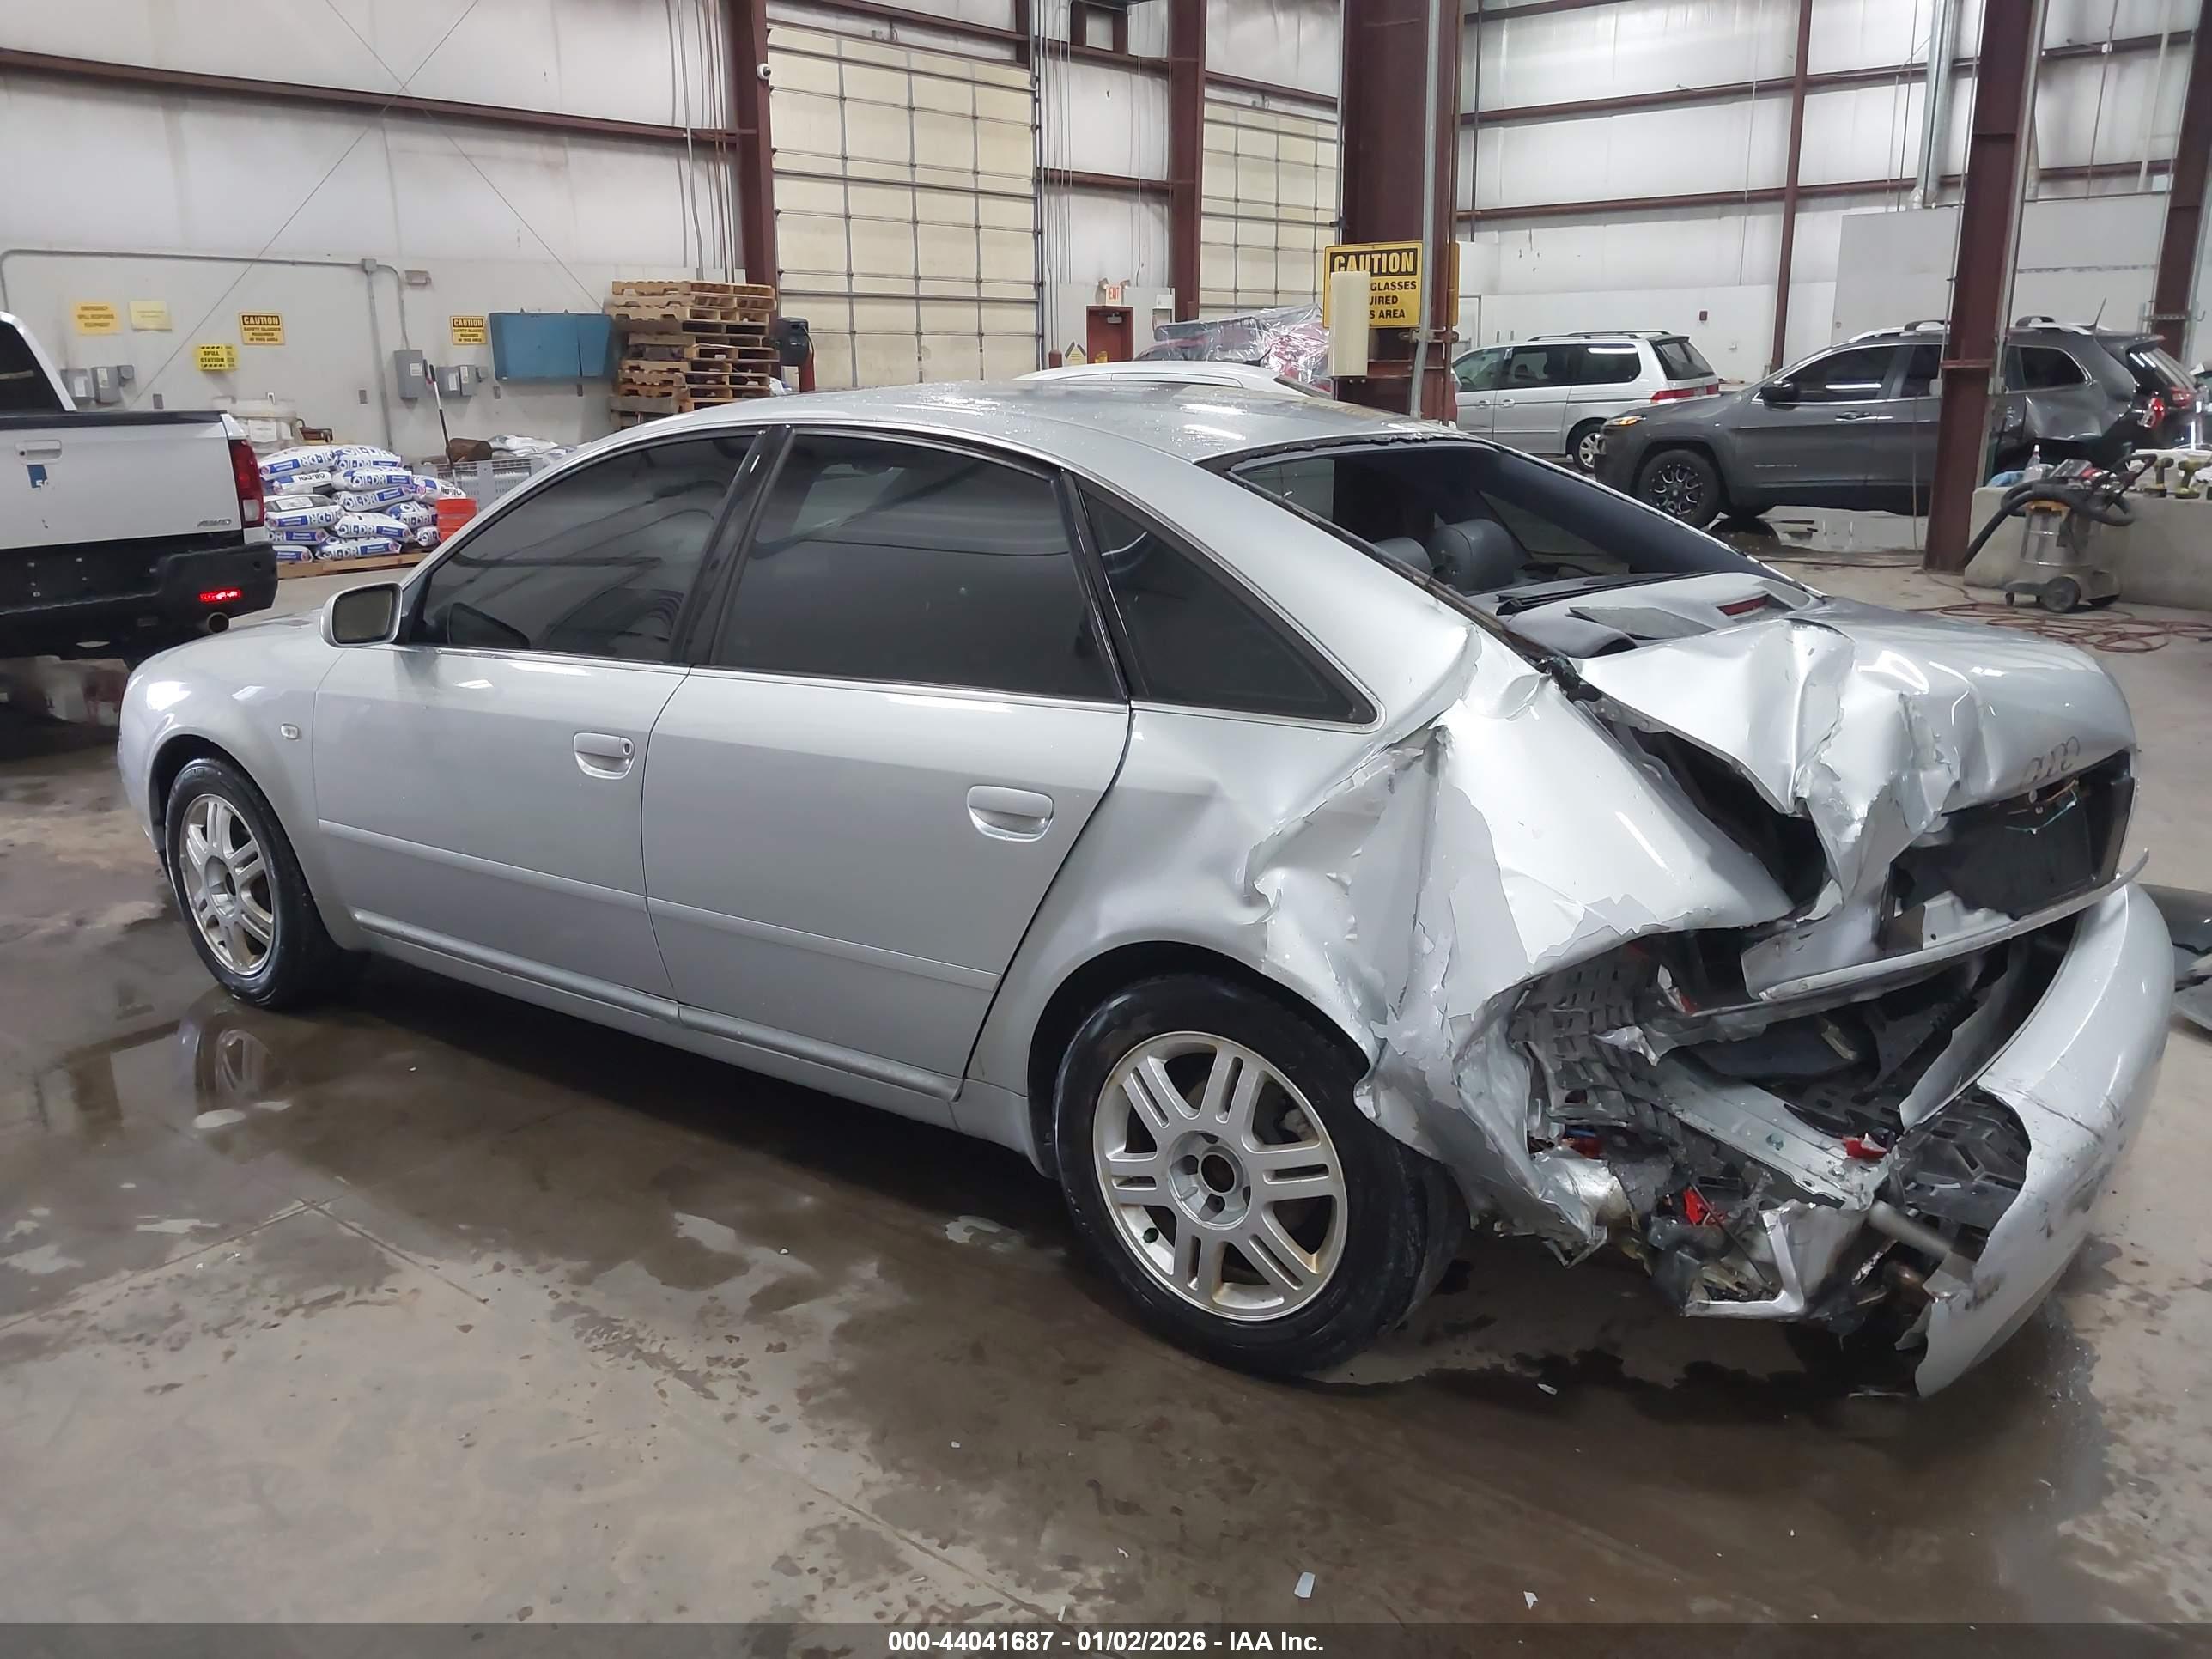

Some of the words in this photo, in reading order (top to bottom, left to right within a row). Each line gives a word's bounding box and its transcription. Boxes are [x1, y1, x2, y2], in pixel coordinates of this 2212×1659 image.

[1334, 251, 1414, 273] CAUTION
[1370, 280, 1417, 291] GLASSES
[1109, 286, 1119, 300] EXIT
[1378, 308, 1406, 319] AREA
[243, 316, 280, 325] CAUTION
